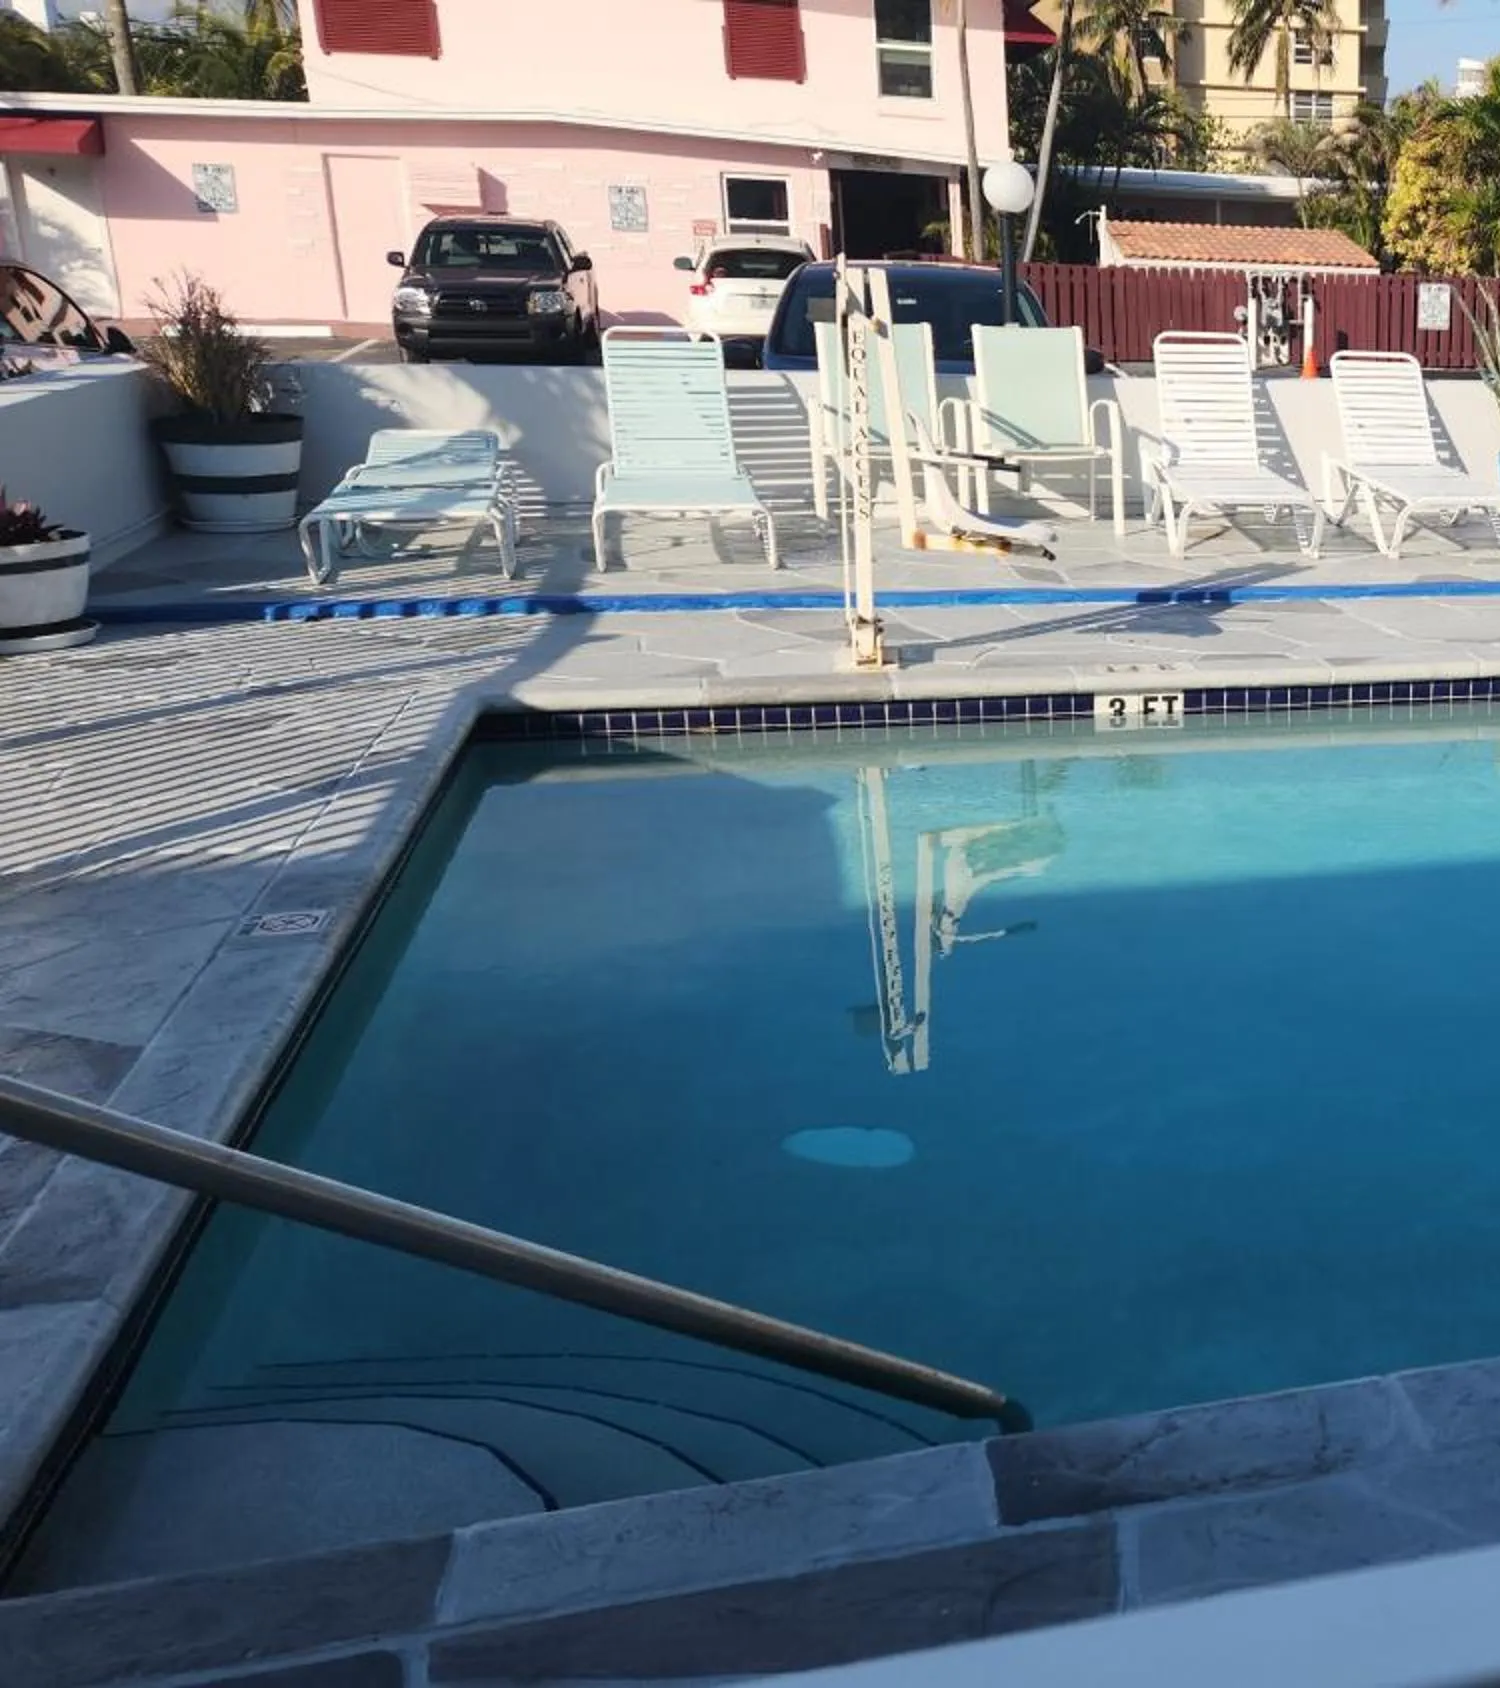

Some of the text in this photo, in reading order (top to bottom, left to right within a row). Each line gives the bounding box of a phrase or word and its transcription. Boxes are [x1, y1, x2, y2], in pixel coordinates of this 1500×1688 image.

[851, 330, 869, 519] EQUAL ACCESS
[1109, 695, 1179, 717] 3 FT
